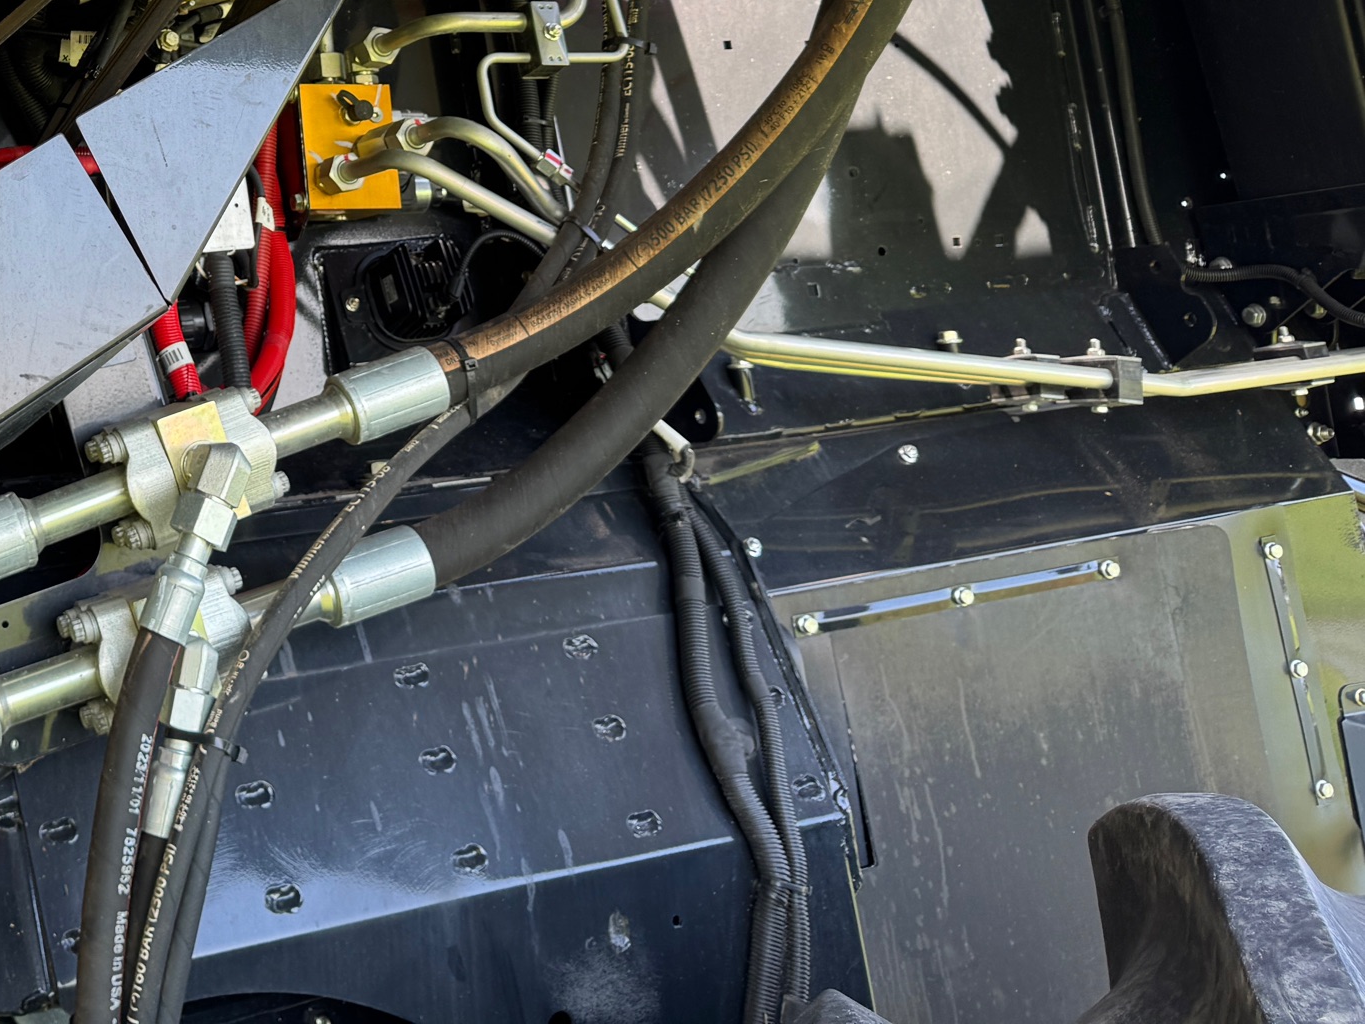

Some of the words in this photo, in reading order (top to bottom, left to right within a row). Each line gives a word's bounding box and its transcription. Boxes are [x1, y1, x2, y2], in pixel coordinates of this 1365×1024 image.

[650, 219, 676, 246] 500
[673, 197, 701, 226] BAR
[113, 911, 128, 954] Made
[112, 957, 124, 972] in
[109, 975, 123, 1011] USA
